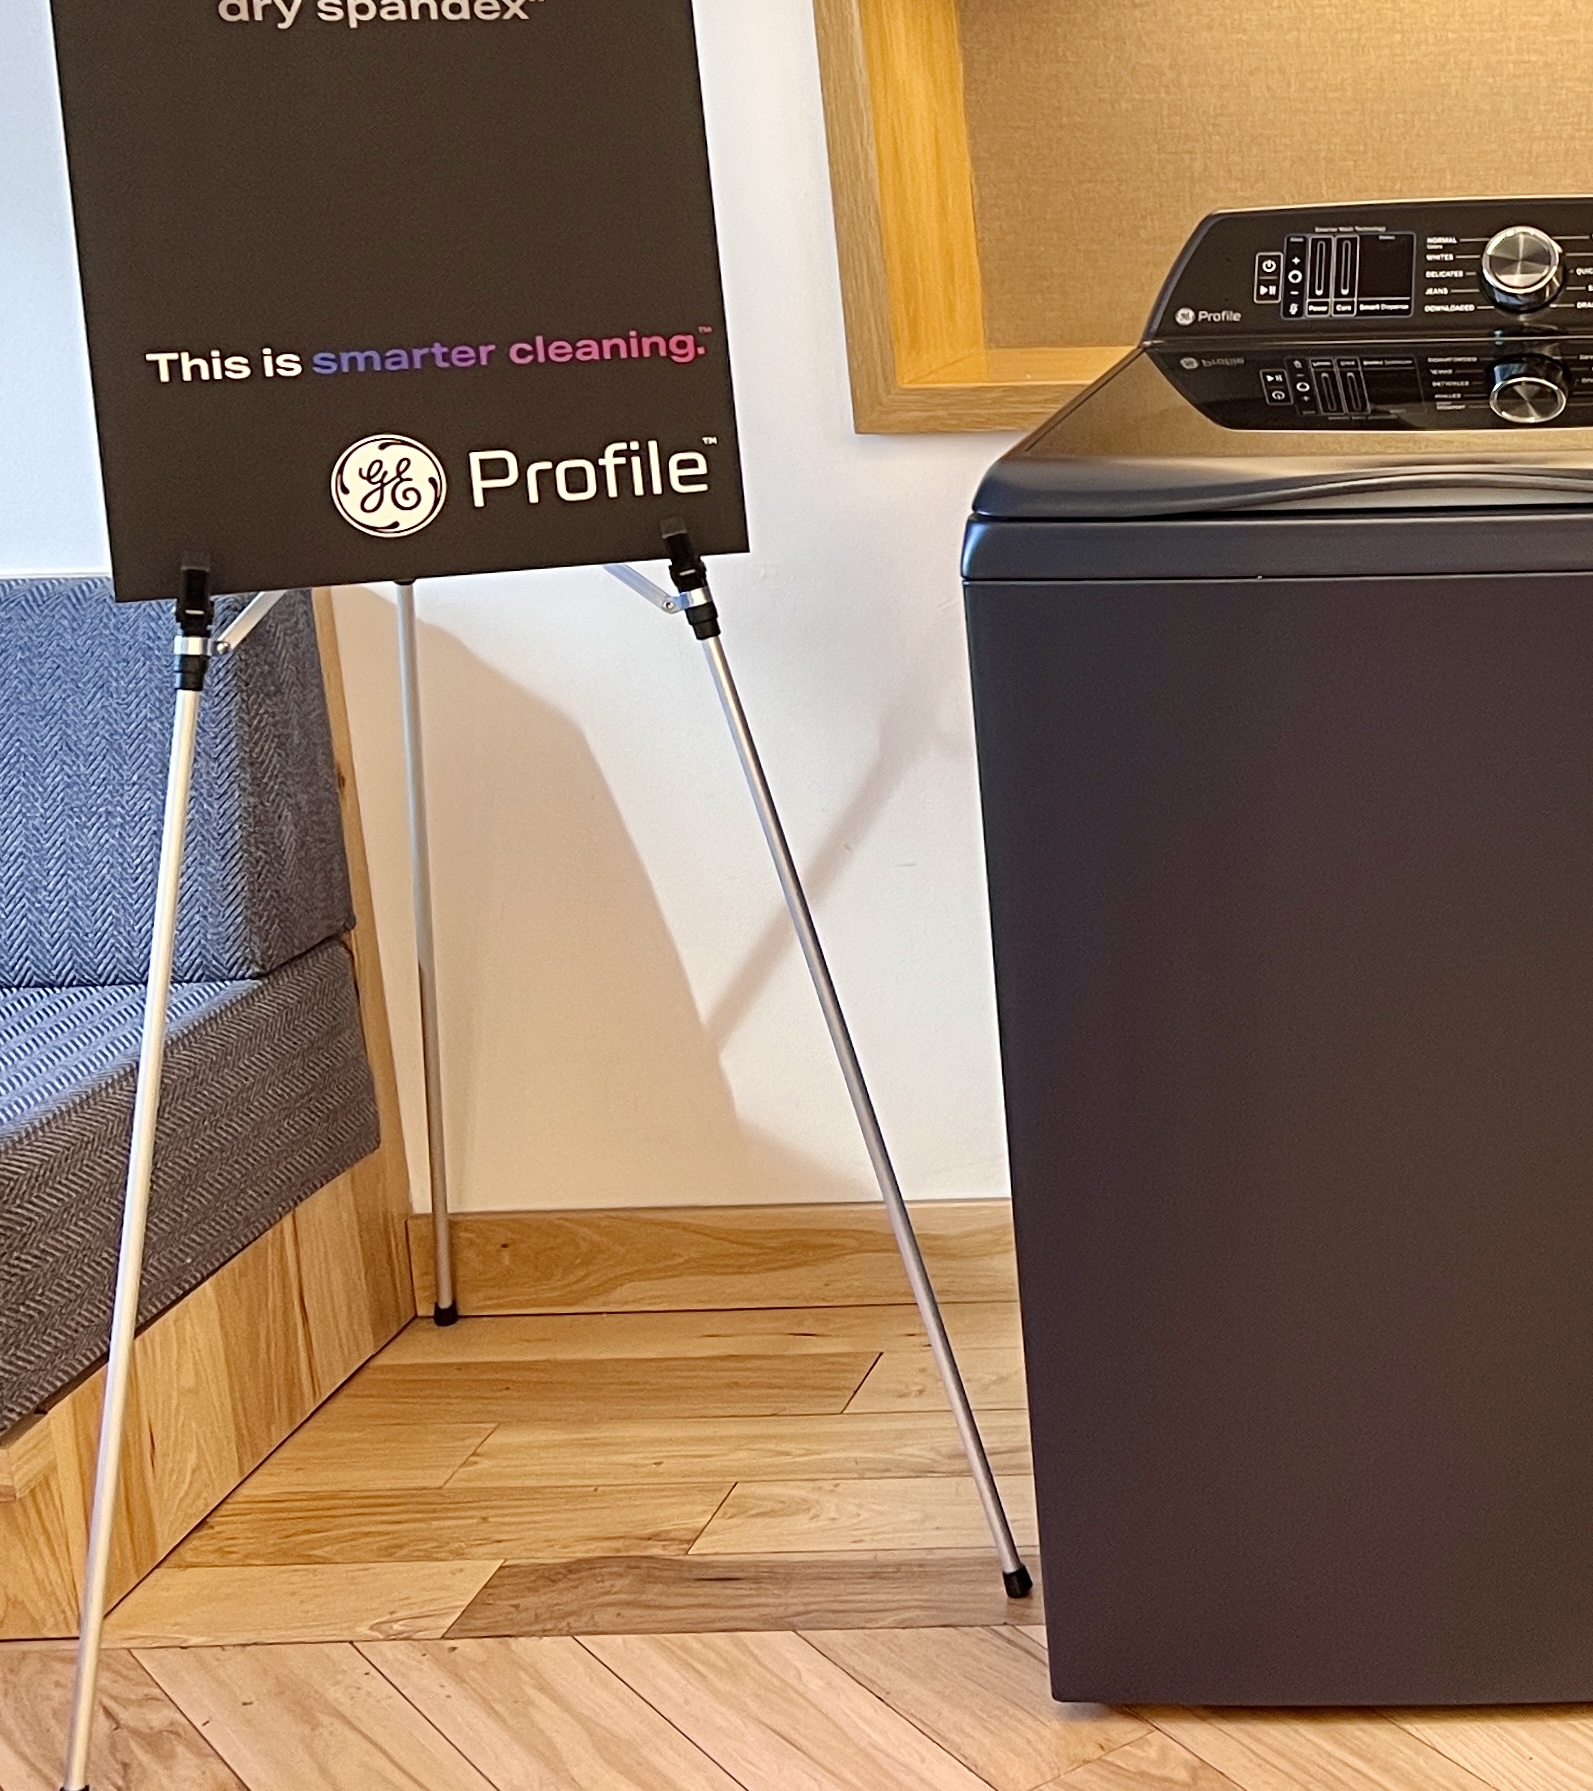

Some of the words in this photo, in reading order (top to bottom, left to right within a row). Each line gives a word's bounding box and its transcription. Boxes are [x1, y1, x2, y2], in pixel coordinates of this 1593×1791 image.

[219, 0, 302, 29] dry
[317, 0, 544, 28] spandex
[1426, 236, 1458, 244] NORMAL
[1425, 253, 1454, 261] WHITES
[1425, 270, 1464, 279] DELICATES
[1424, 287, 1449, 295] JEANS
[1424, 303, 1476, 313] DOWNLOADED
[1197, 310, 1242, 322] Profile
[146, 350, 251, 382] This
[263, 348, 302, 377] is
[313, 343, 496, 374] smarter
